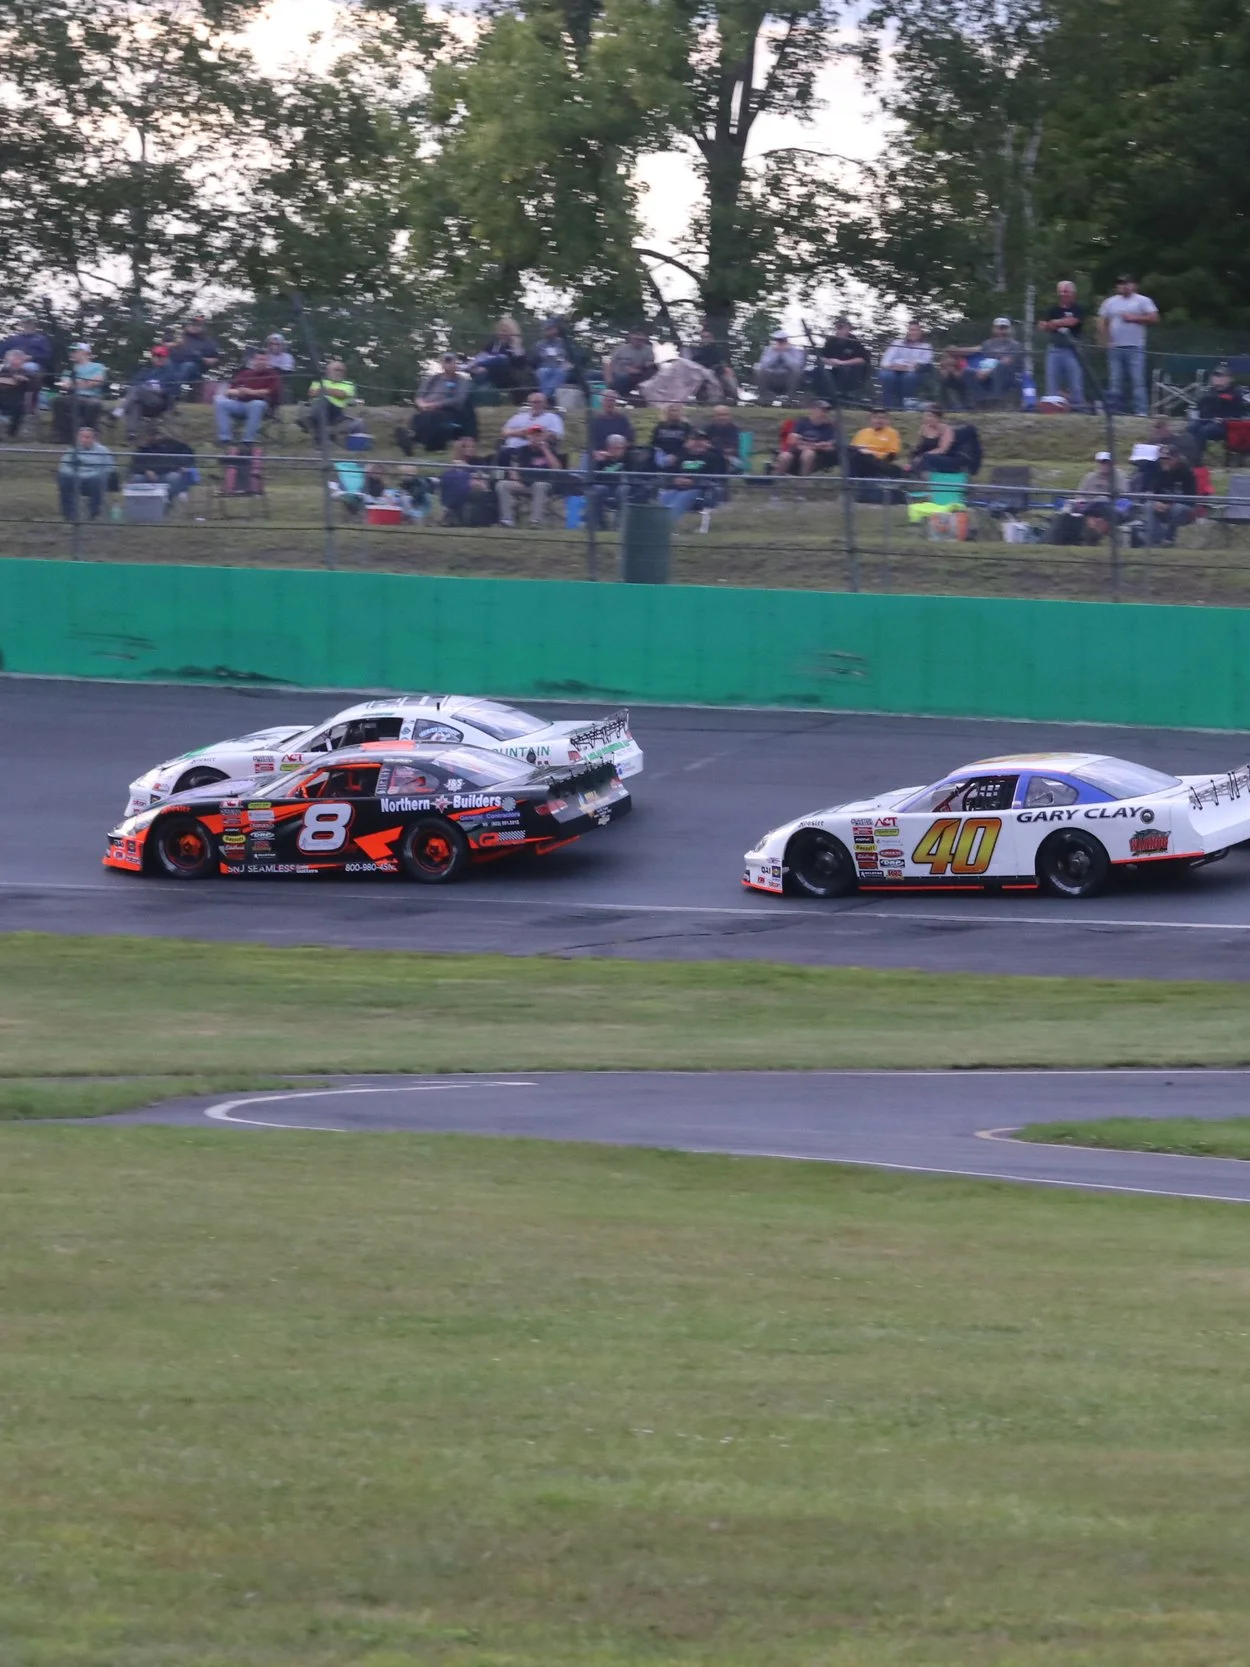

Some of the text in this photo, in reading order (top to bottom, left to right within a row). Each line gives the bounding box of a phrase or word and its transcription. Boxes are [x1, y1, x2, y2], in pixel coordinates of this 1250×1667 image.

[381, 795, 502, 813] Northern Builders
[875, 817, 898, 827] ACT
[1016, 806, 1143, 823] GARY CLAY
[297, 802, 354, 853] 8
[911, 817, 1002, 874] 40
[247, 864, 296, 873] SEAMLESS
